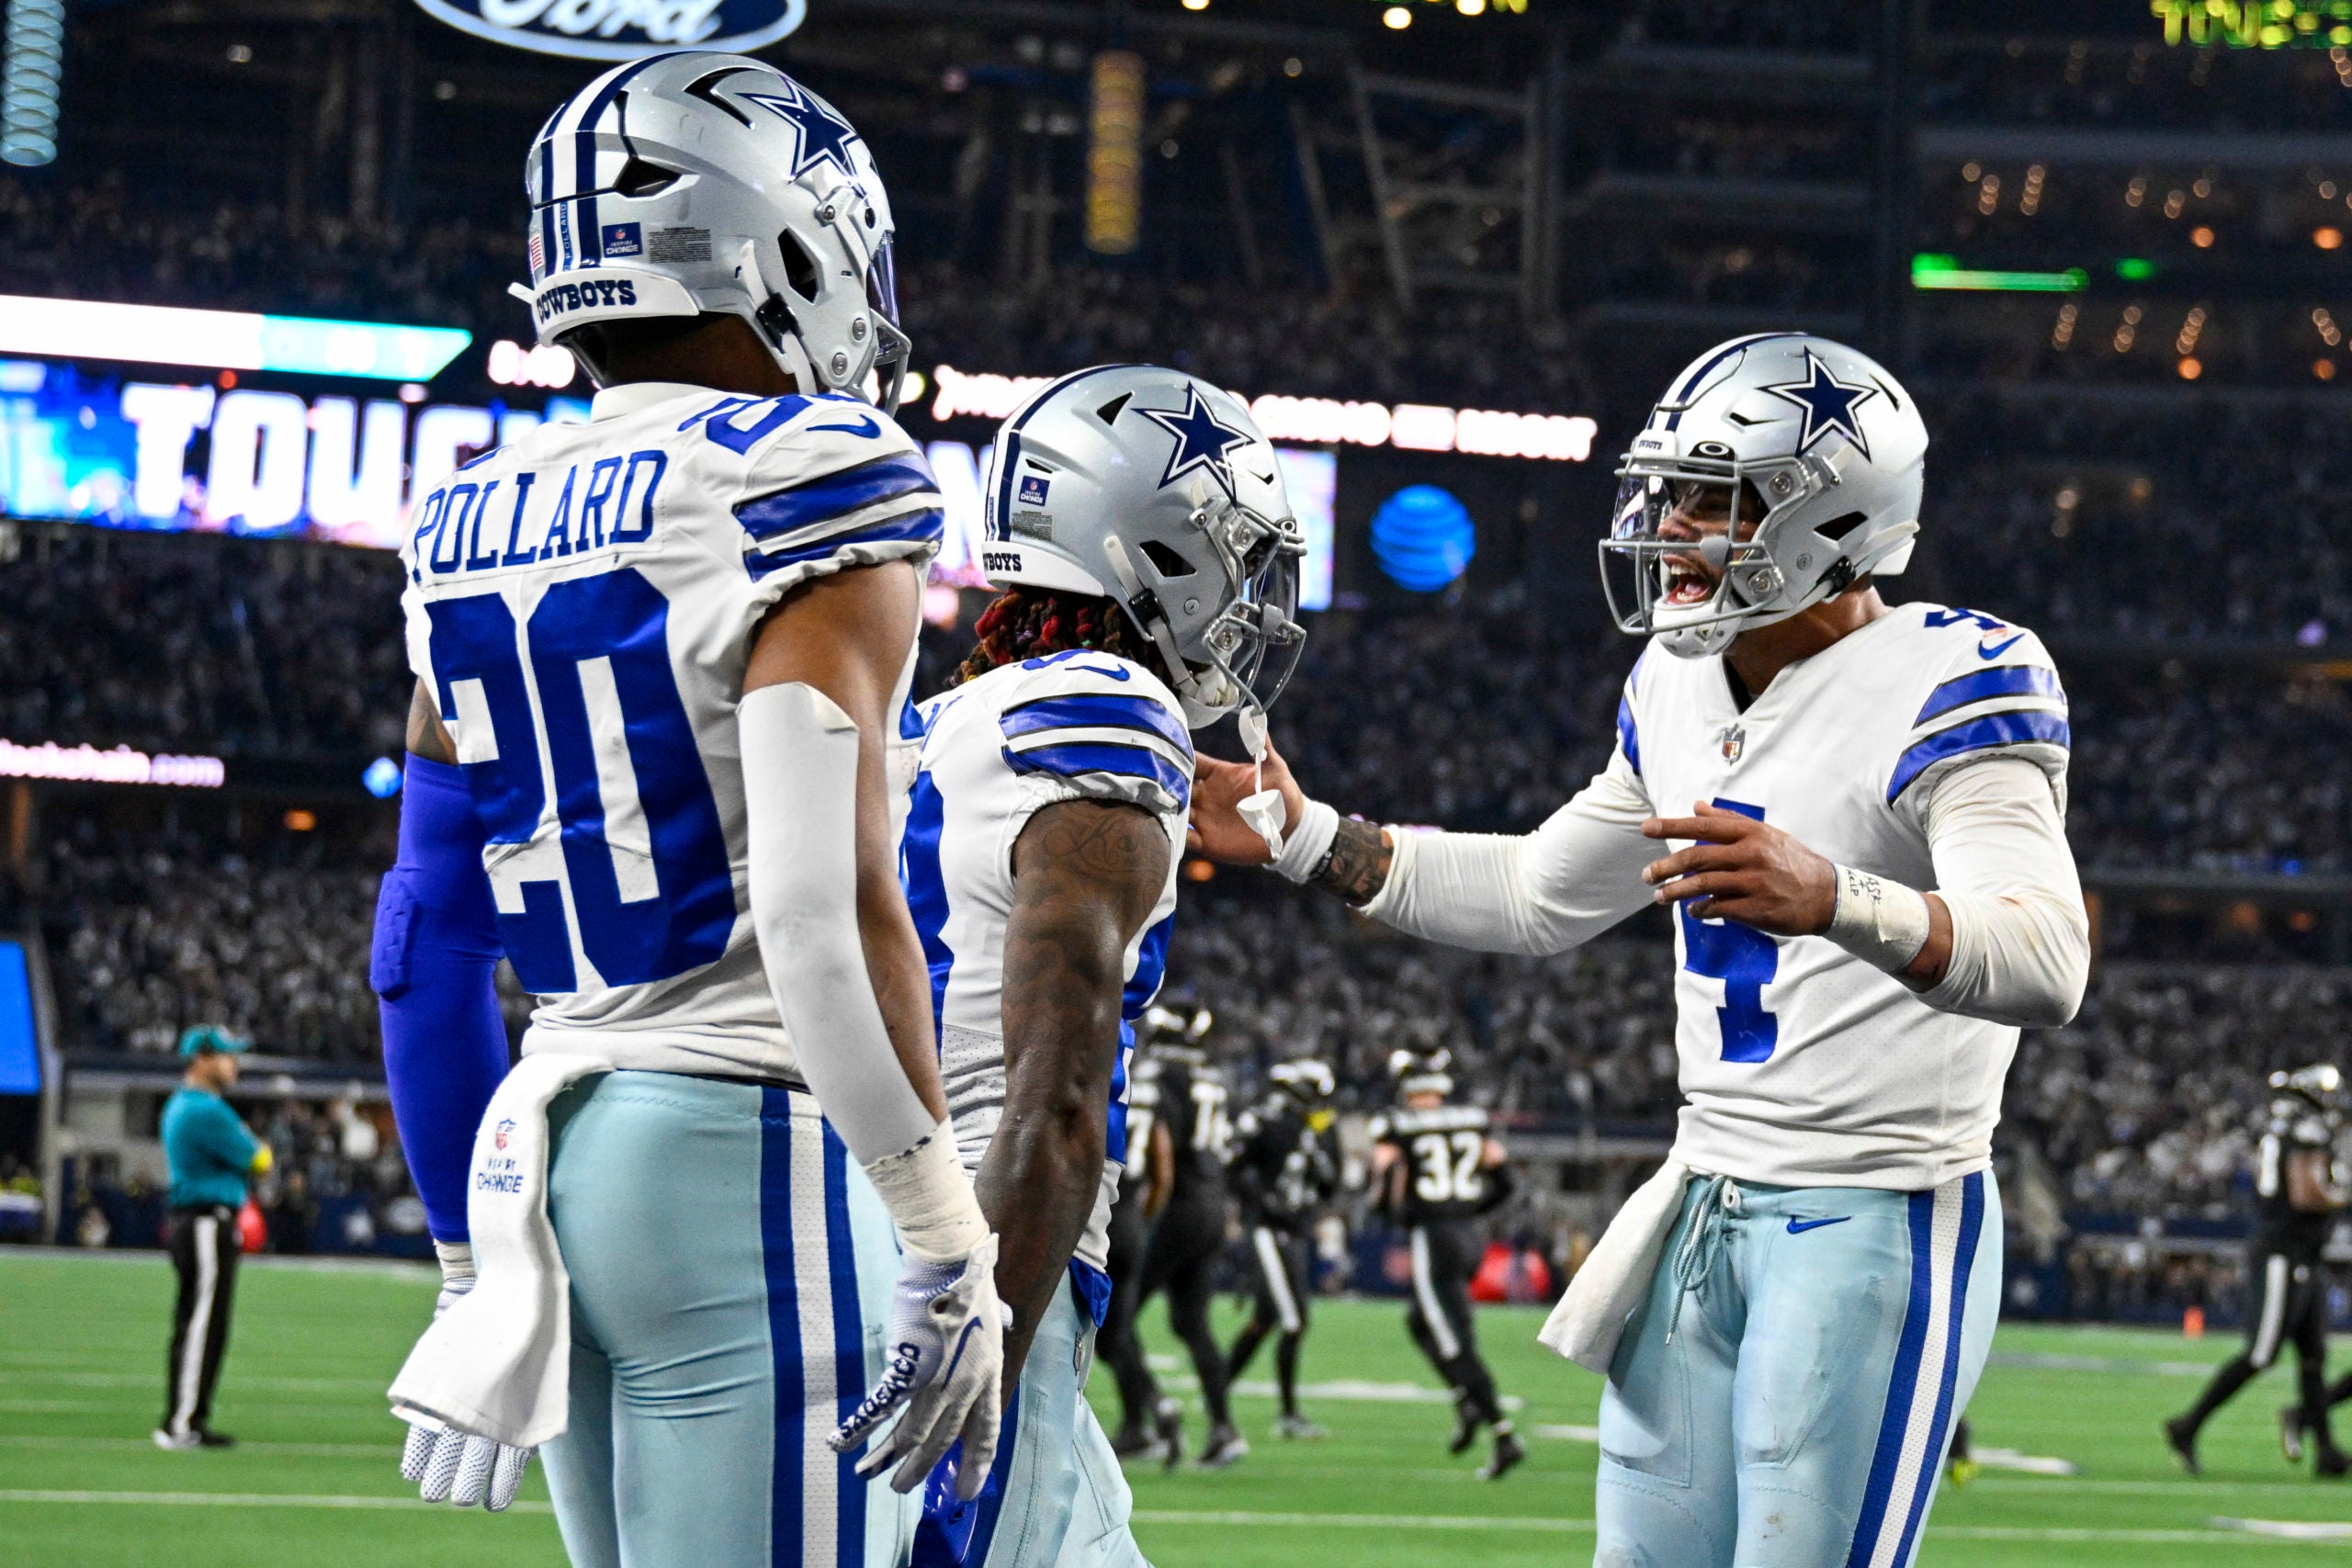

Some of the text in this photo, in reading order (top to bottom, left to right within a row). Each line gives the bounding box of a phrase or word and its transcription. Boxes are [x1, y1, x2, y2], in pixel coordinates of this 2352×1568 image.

[606, 245, 639, 255] CHANGE
[537, 280, 637, 324] COWBOYS
[413, 449, 668, 583] POLLARD
[424, 567, 738, 994] 20
[1412, 1131, 1483, 1201] 32
